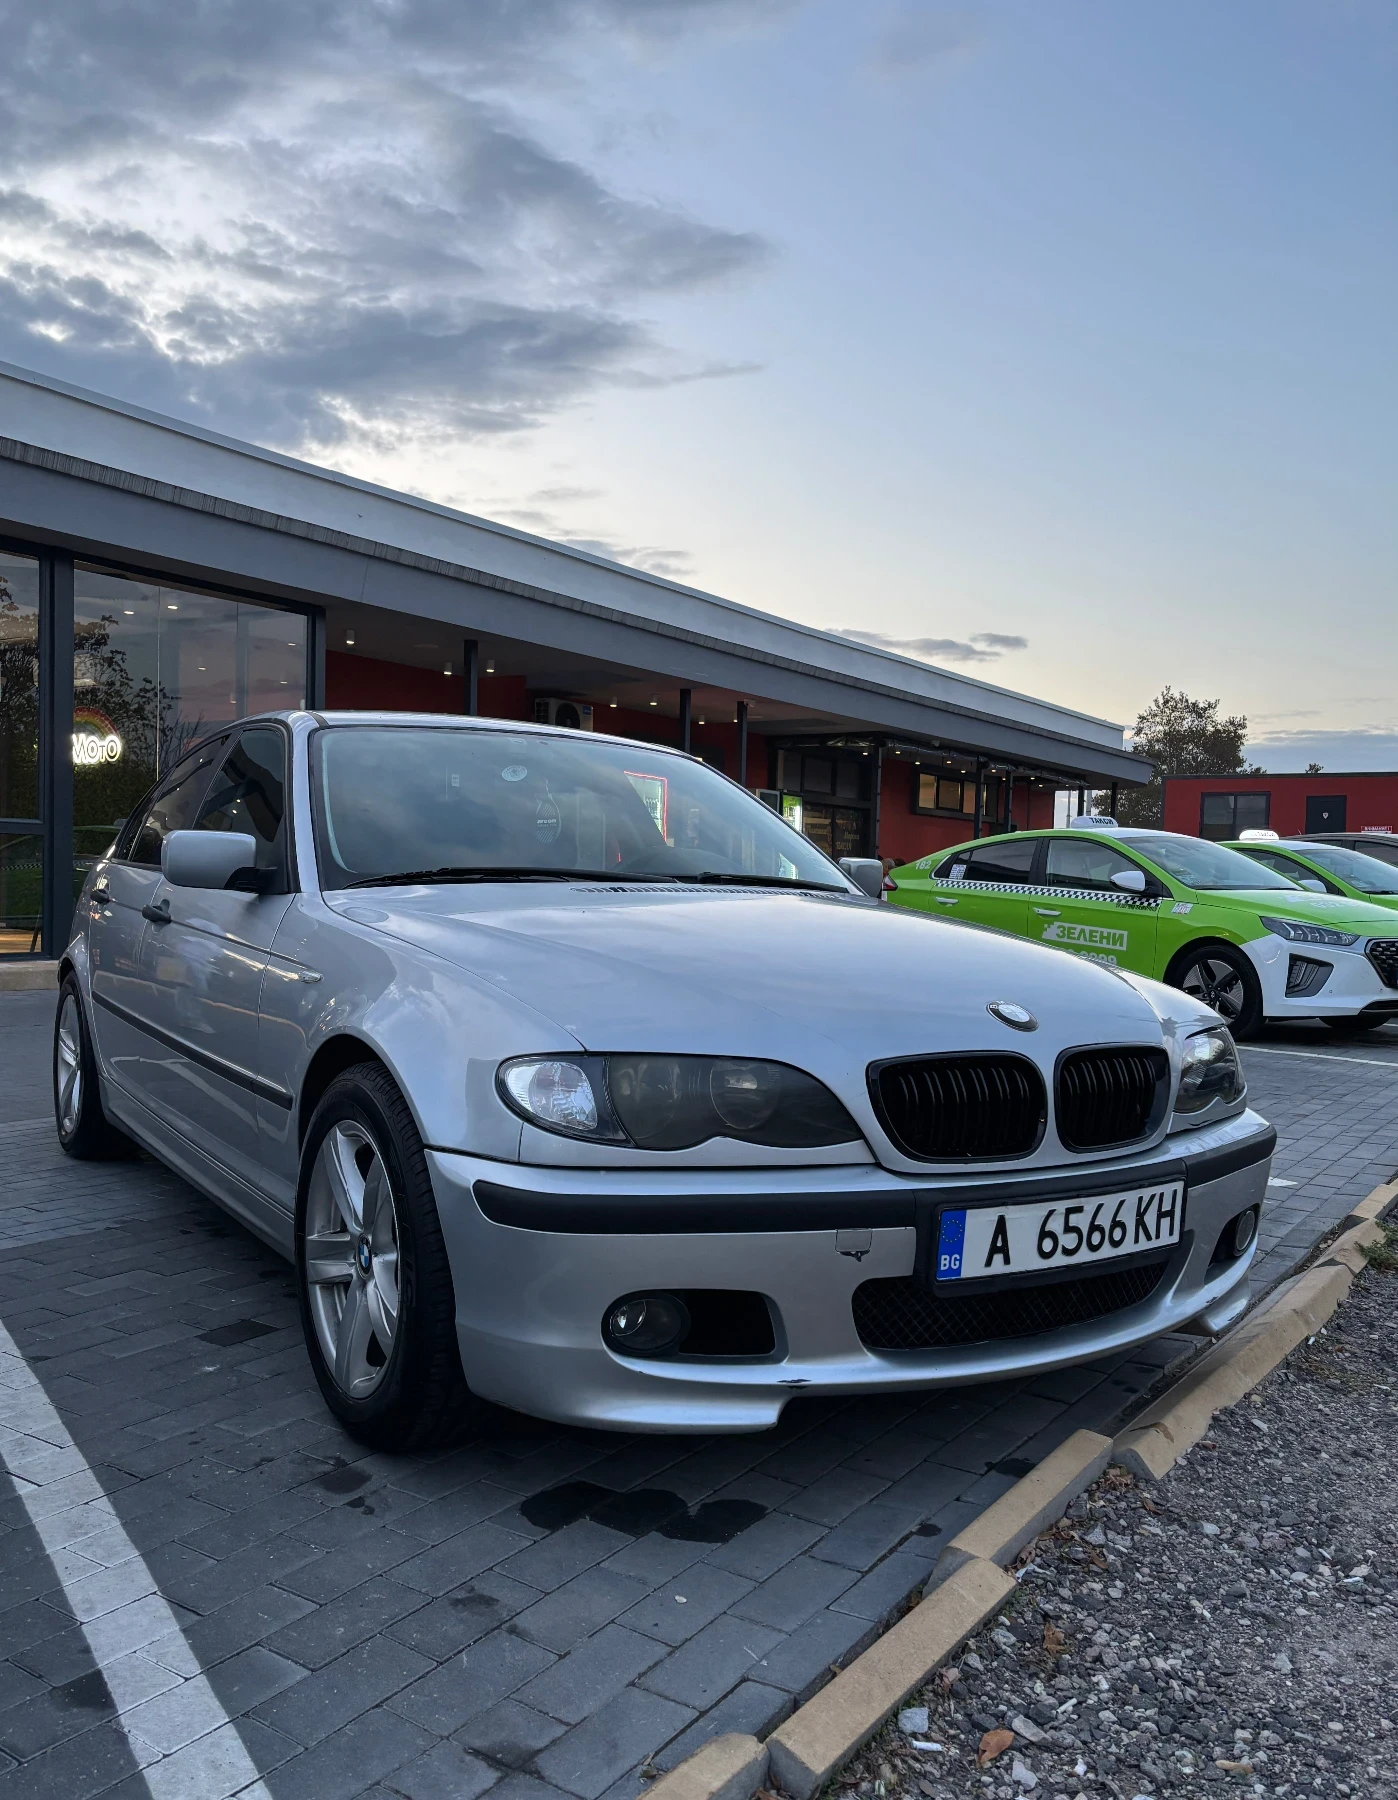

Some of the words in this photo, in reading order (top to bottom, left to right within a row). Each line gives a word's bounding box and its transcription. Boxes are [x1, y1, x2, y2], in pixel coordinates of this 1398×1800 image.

[1088, 816, 1114, 826] ТАКСИ
[915, 859, 932, 870] 182
[1055, 924, 1125, 948] ЗЕЛЕНИ
[984, 1213, 1011, 1268] A
[1036, 1198, 1128, 1260] 6566
[1133, 1188, 1178, 1245] KH
[939, 1253, 960, 1271] BG
